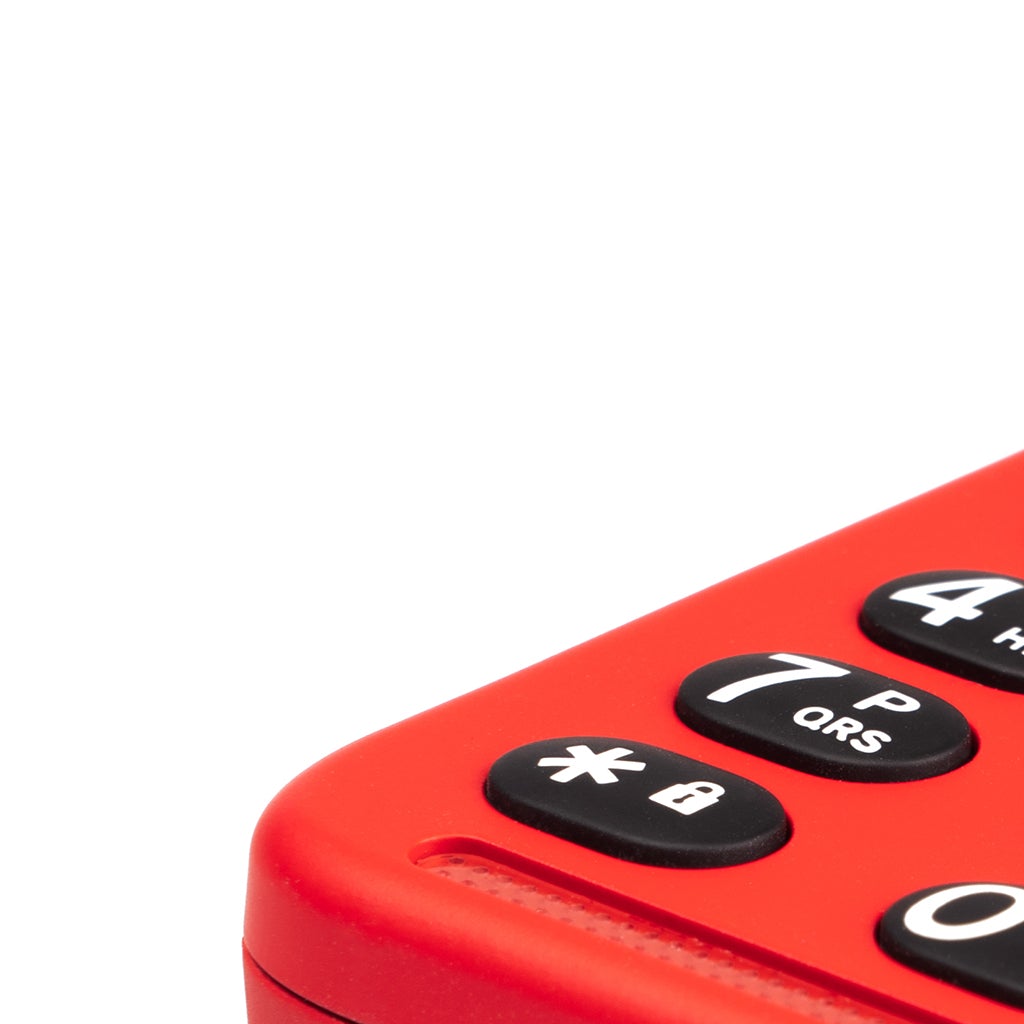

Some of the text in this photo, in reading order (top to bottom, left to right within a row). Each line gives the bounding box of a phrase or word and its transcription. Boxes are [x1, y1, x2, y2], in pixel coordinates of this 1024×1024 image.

[706, 652, 852, 703] 7
[852, 689, 921, 713] P
[792, 706, 892, 754] QRS
